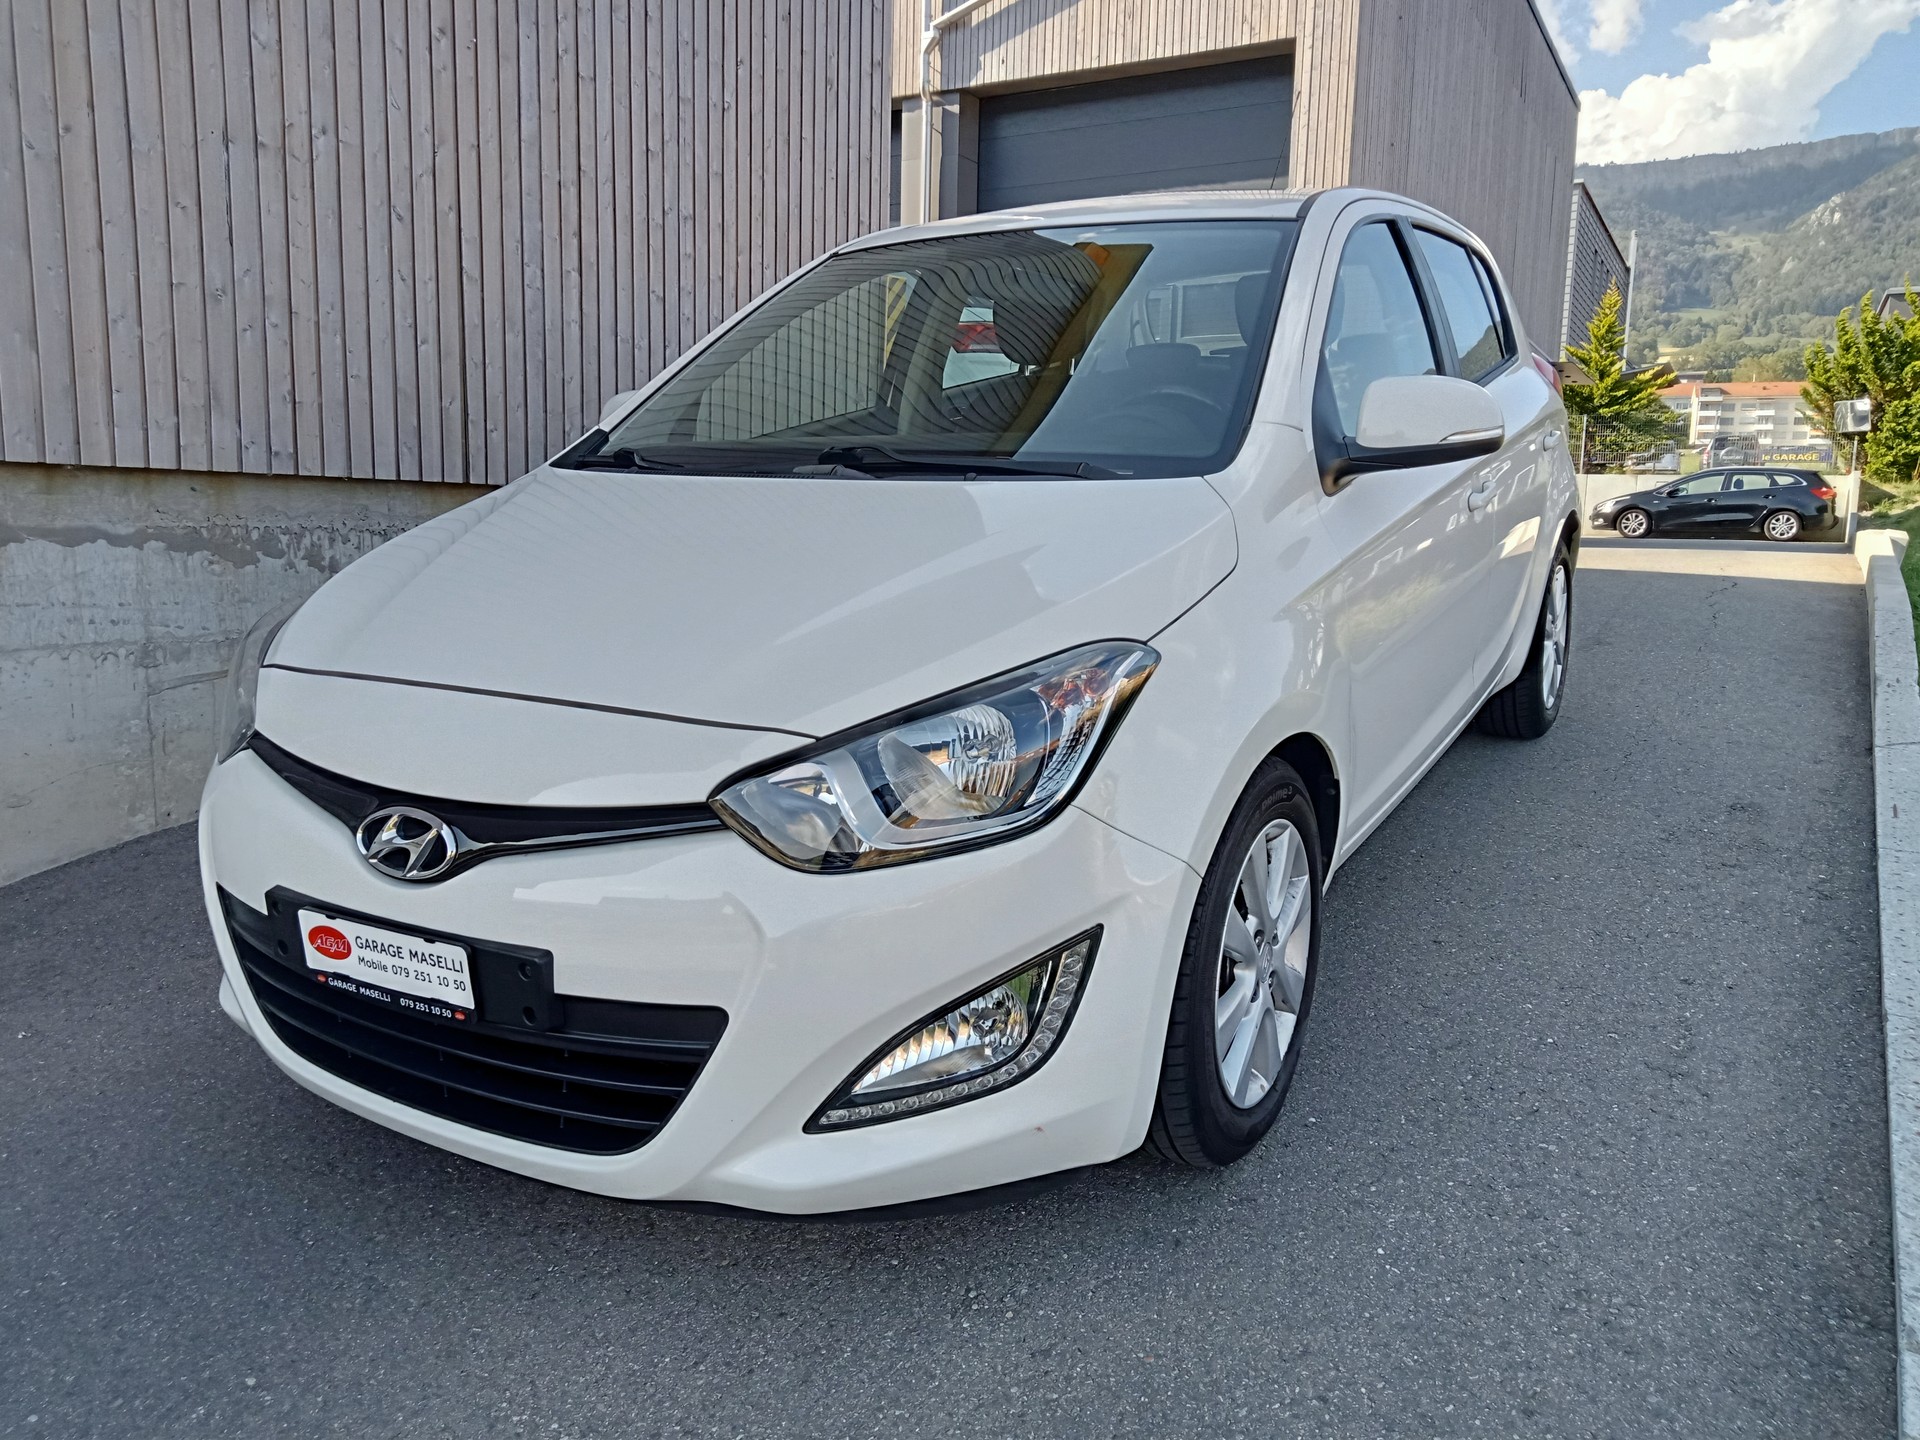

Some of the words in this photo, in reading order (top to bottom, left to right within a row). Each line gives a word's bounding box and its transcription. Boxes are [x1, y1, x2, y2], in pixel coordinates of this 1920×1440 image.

[1762, 453, 1771, 461] le
[1772, 453, 1820, 461] GARAGE
[313, 934, 348, 953] AGM
[355, 935, 405, 960] GARAGE
[409, 948, 464, 974] MASELLI
[357, 955, 389, 973] Mobile
[391, 966, 410, 978] 079
[414, 970, 433, 984] 251
[437, 975, 449, 988] 10
[453, 979, 466, 992] 50
[328, 977, 357, 993] GARAGE
[359, 987, 391, 1002] MASELLI
[399, 997, 414, 1009] 079
[415, 1001, 430, 1013] 251
[431, 1005, 441, 1015] 10
[441, 1008, 452, 1018] 50
